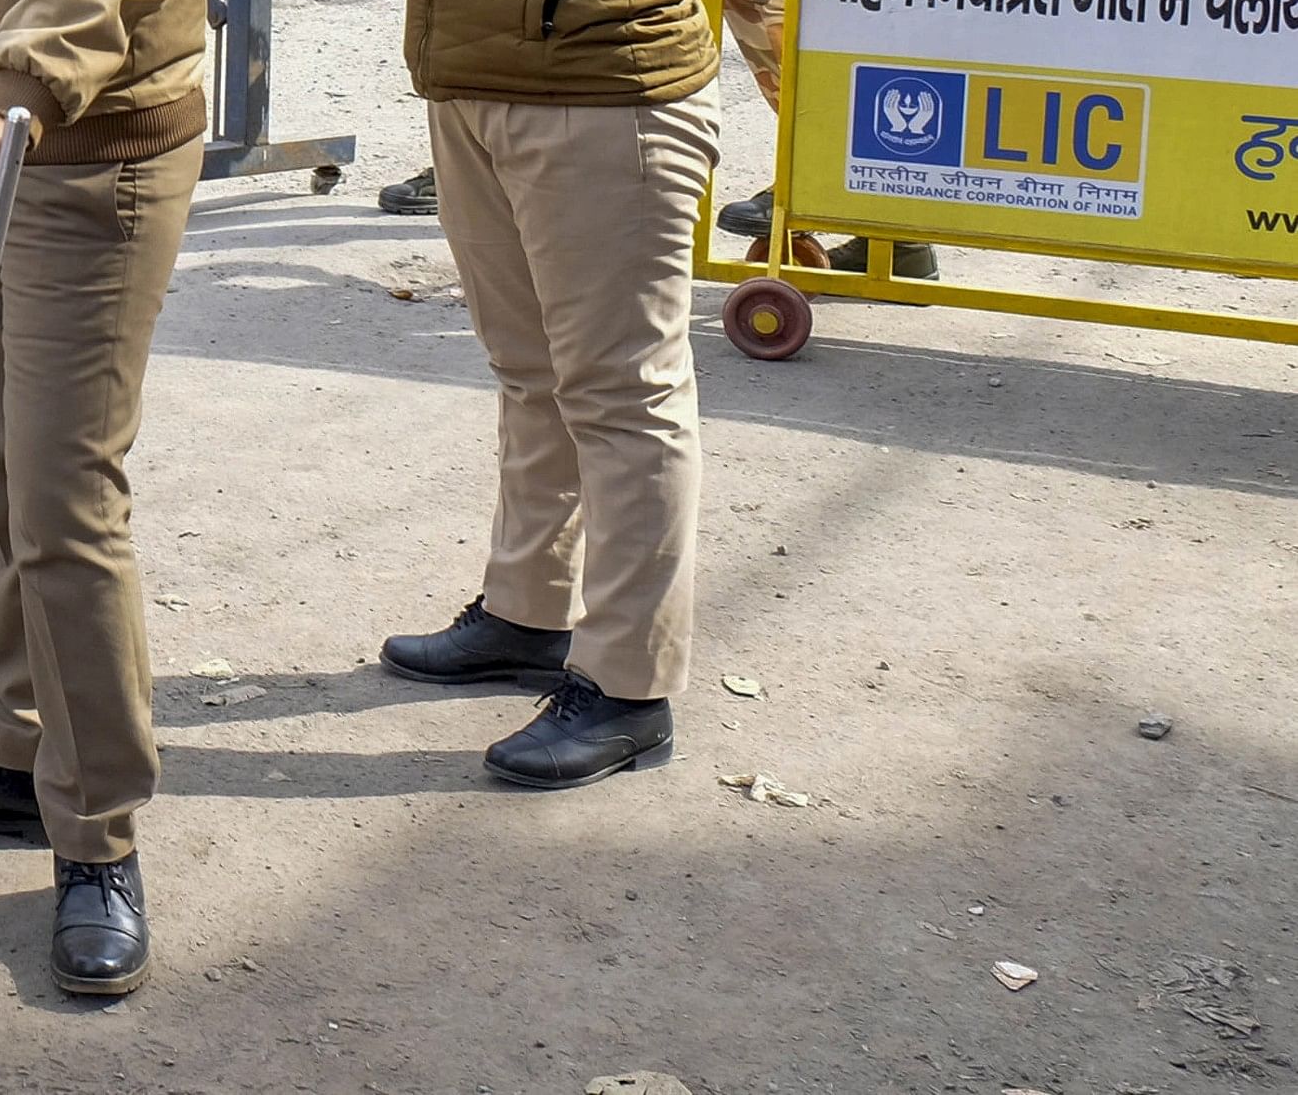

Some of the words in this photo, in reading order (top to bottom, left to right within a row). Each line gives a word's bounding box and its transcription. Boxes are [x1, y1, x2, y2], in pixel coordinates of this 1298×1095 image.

[983, 86, 1125, 172] LIC
[848, 179, 877, 192] LIFE
[881, 181, 962, 201] INSURANCE
[966, 190, 1069, 211] CORPORATION
[1072, 200, 1093, 212] OF
[1096, 201, 1138, 217] INDIA
[849, 162, 929, 185] भारतीय
[941, 167, 1004, 191] जीवन
[1014, 174, 1065, 197] बीमा
[1077, 180, 1139, 204] निगम
